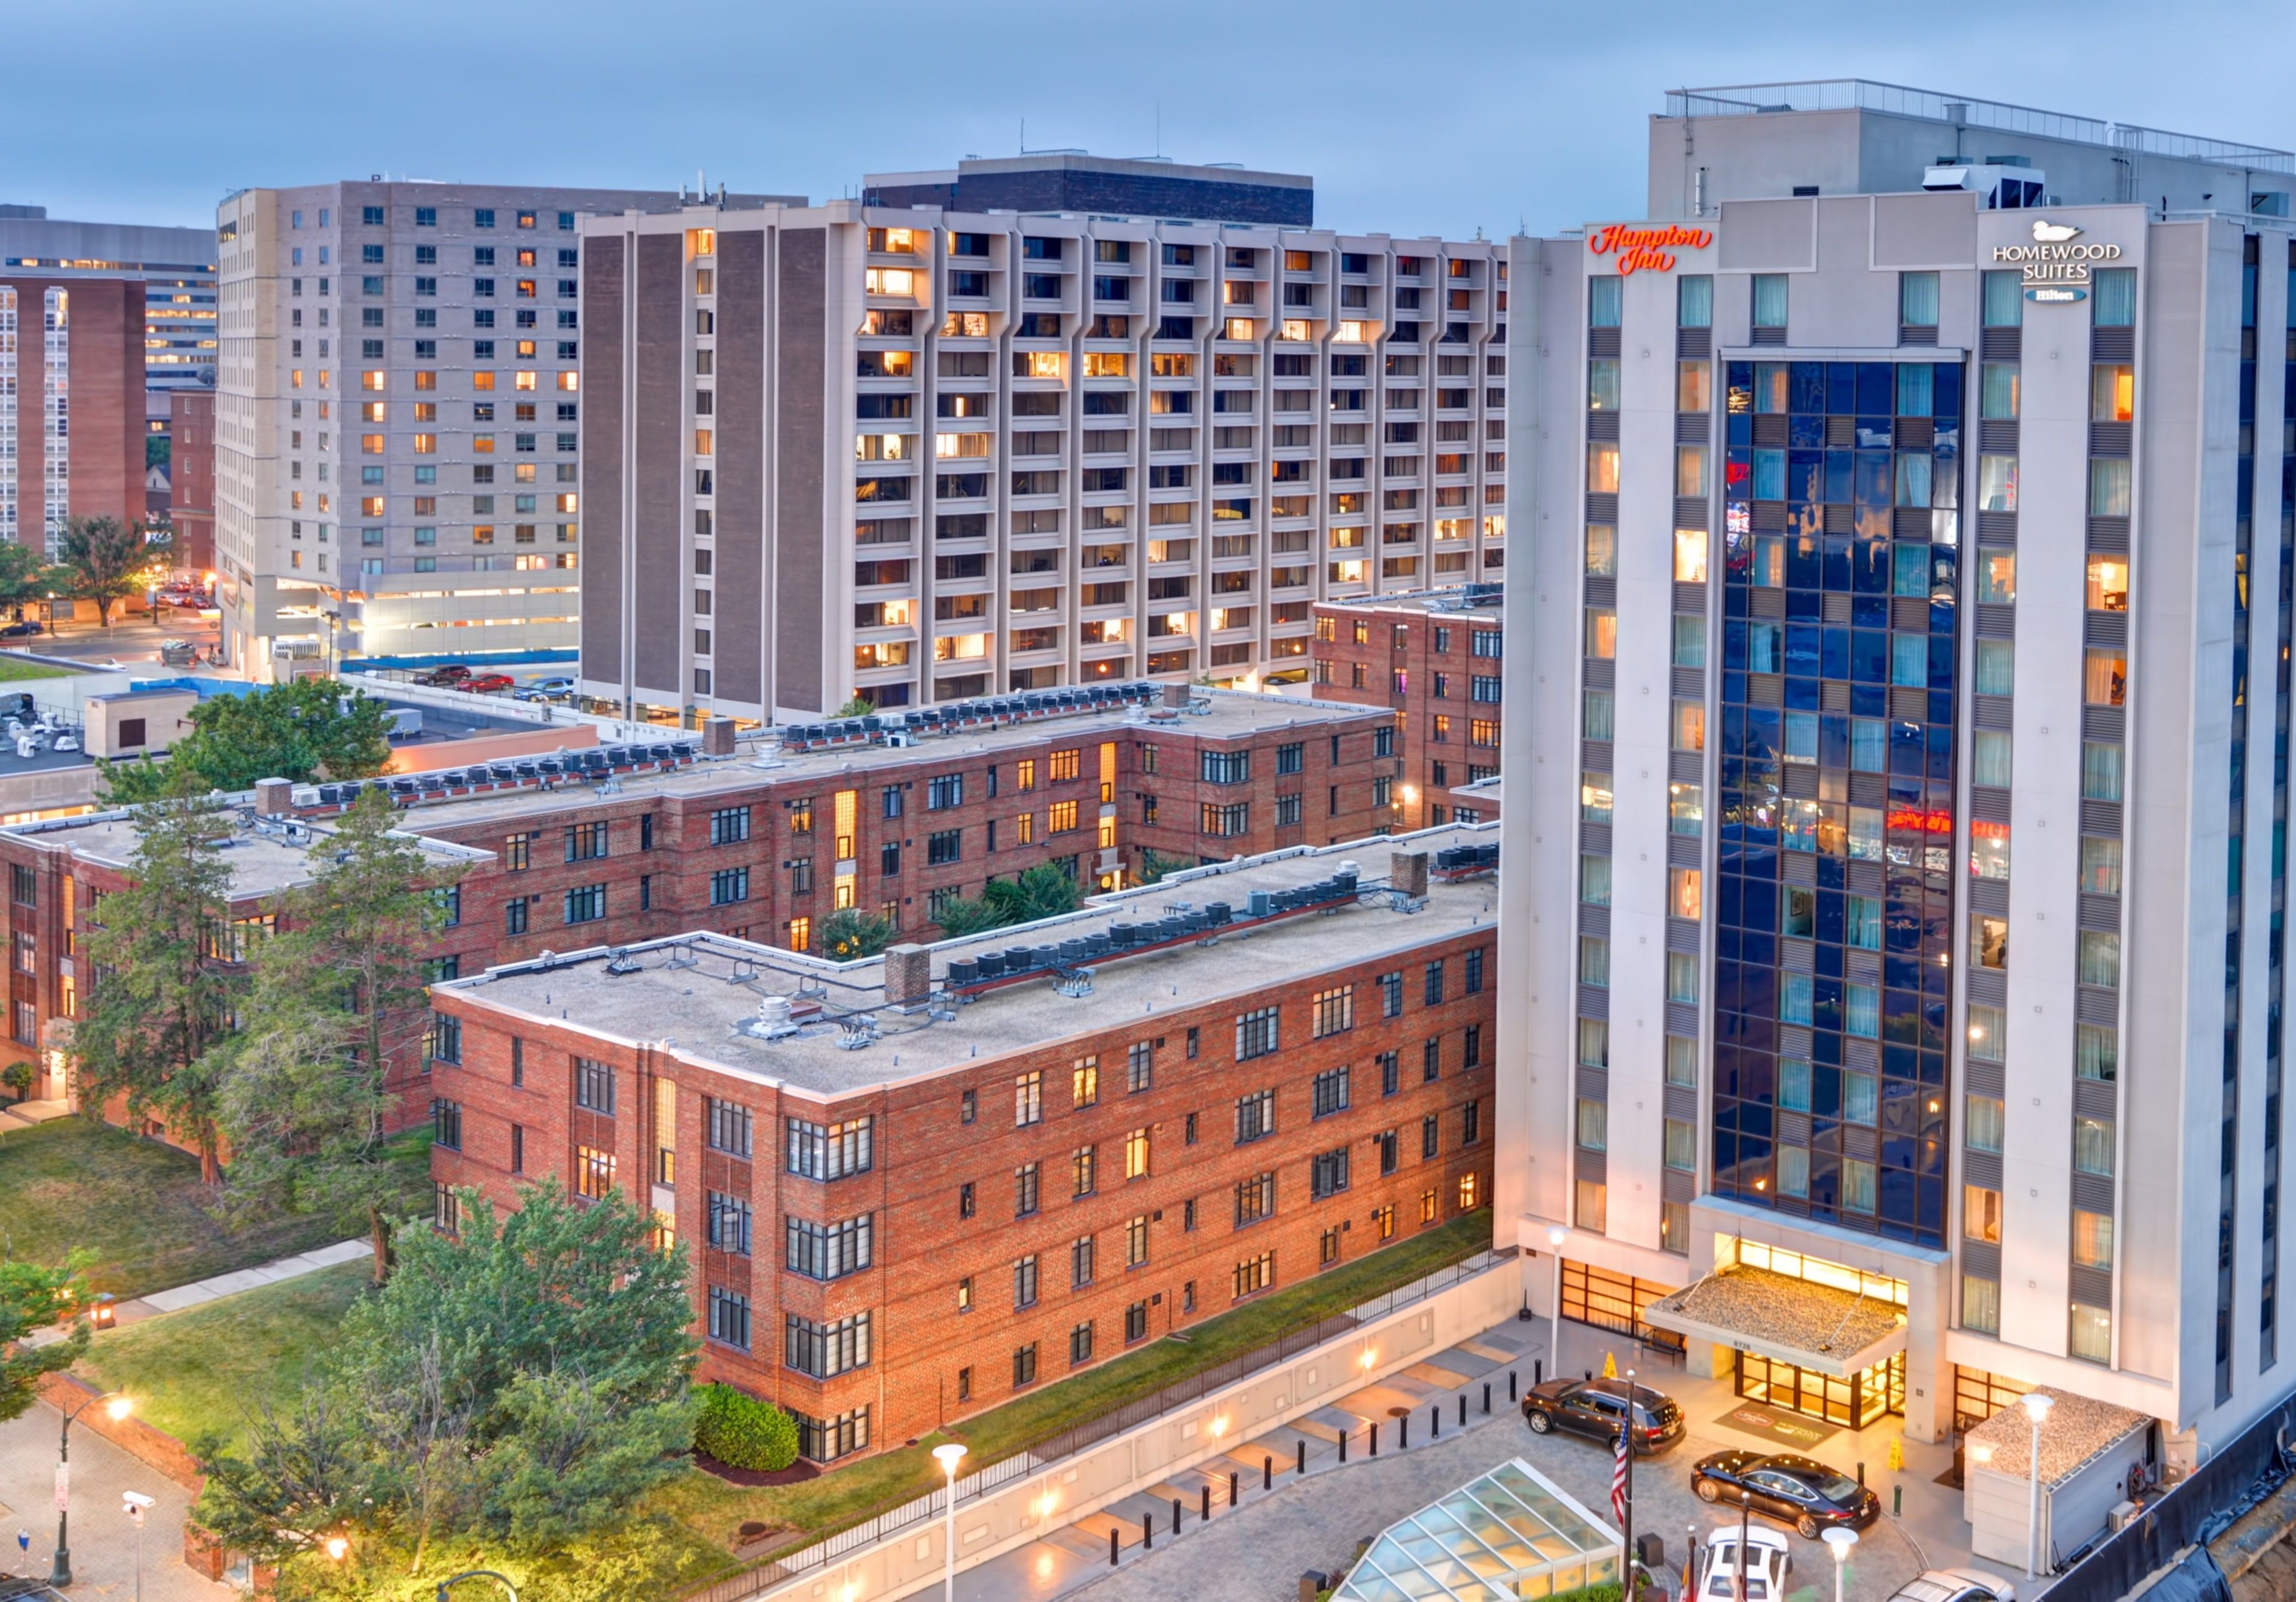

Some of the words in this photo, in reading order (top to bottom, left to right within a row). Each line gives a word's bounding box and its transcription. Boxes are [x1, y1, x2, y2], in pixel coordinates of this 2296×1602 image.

[1589, 224, 1712, 255] Hampton
[1617, 246, 1675, 276] Inn
[1993, 244, 2121, 261] HOMEWOOD
[2023, 264, 2088, 279] SUITES
[2035, 289, 2074, 301] Hilton
